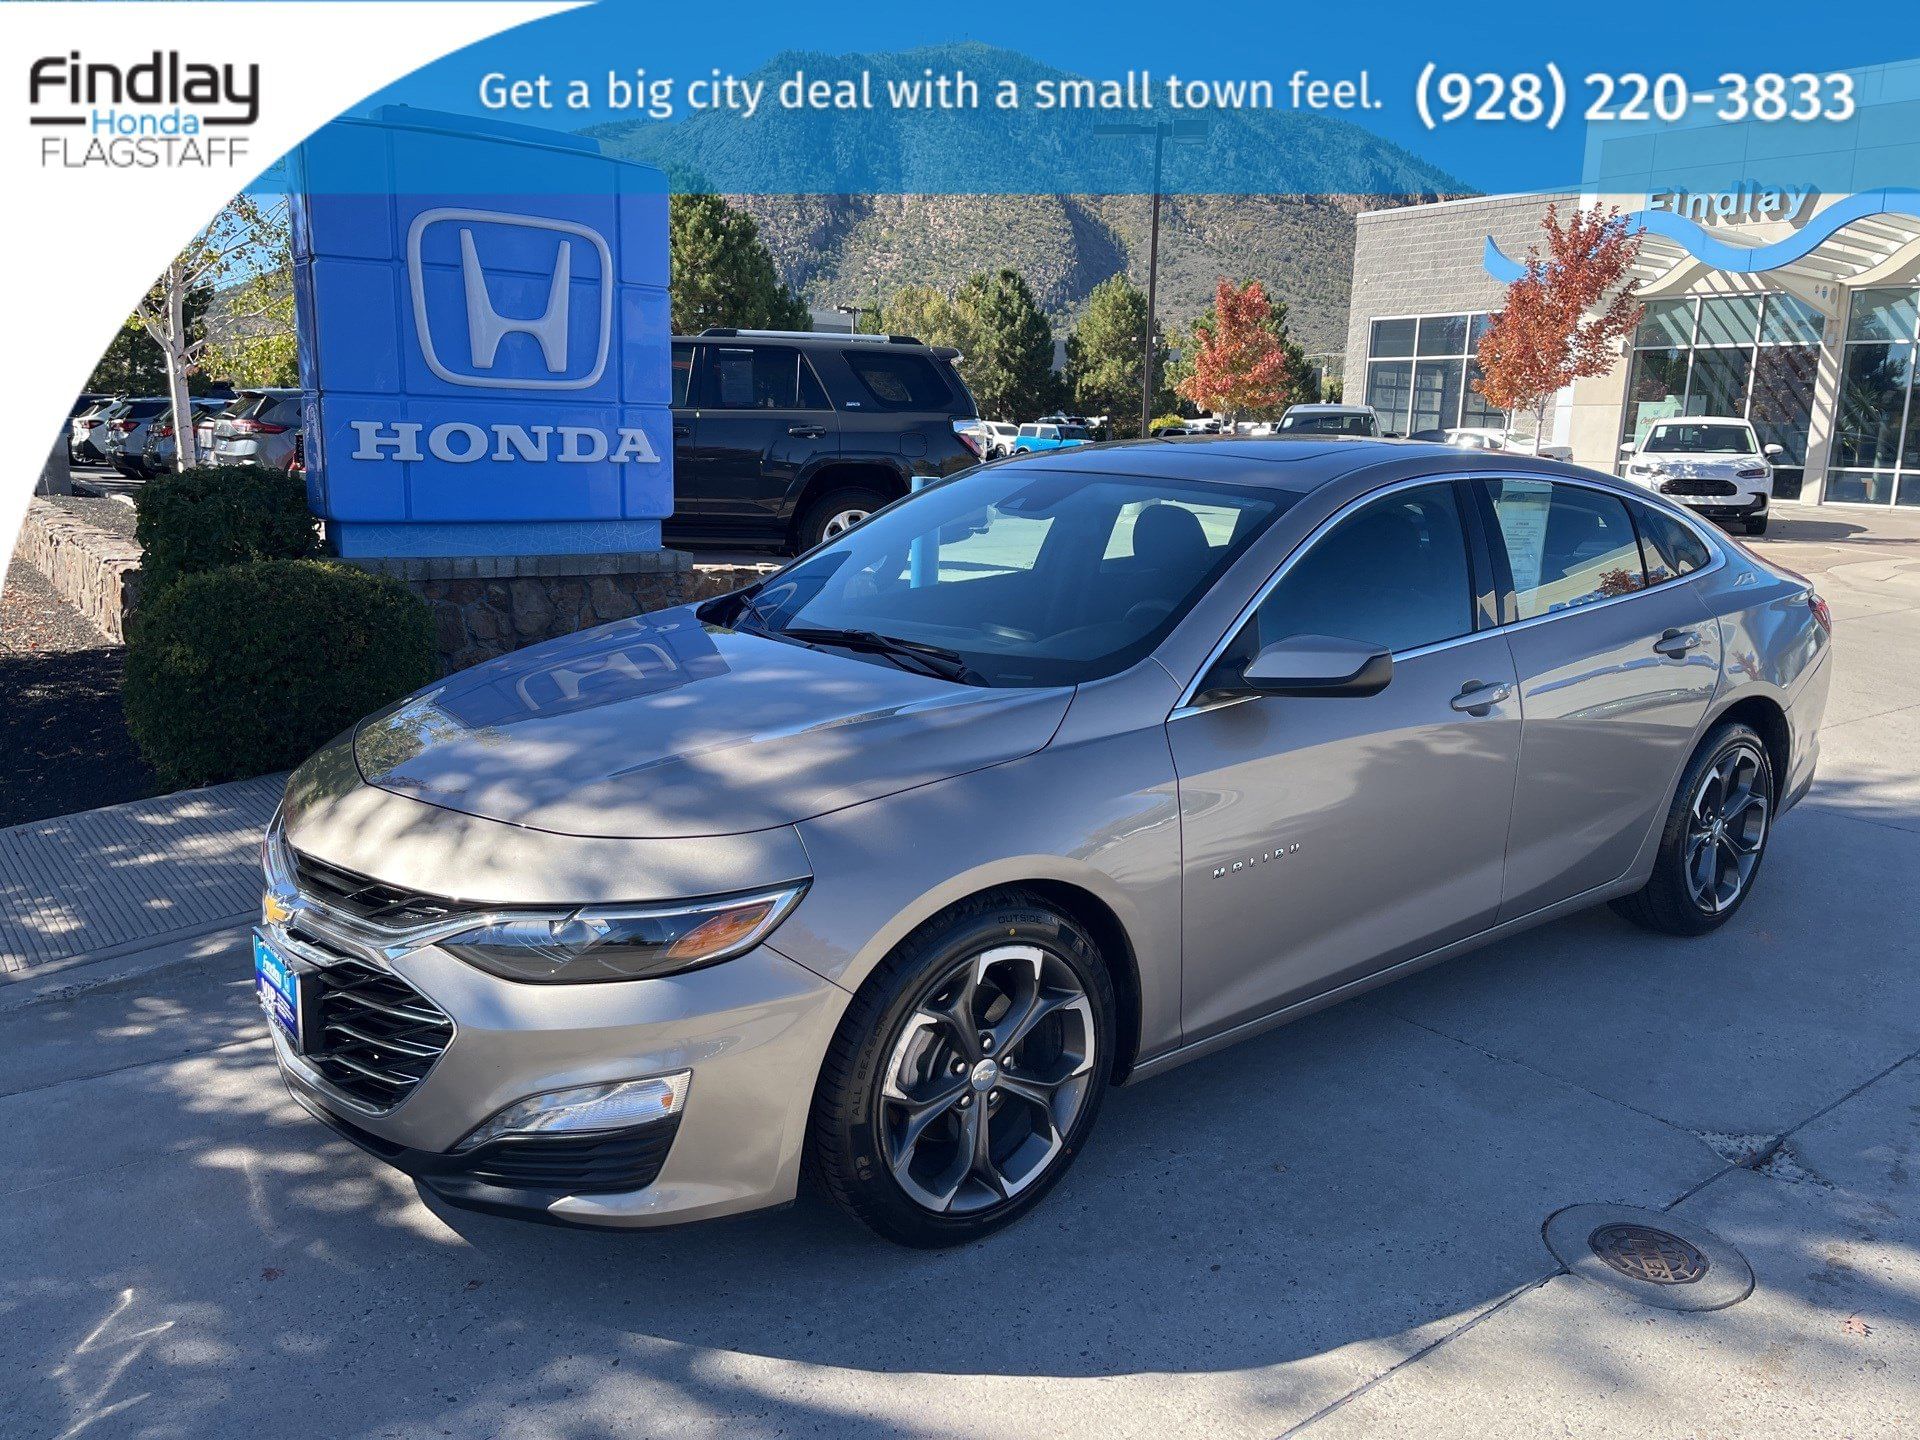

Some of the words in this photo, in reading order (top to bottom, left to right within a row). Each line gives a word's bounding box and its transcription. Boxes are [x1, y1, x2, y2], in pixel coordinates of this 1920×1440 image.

[1645, 179, 1814, 222] Findlay
[350, 420, 661, 463] HONDA
[851, 1087, 863, 1117] ALL
